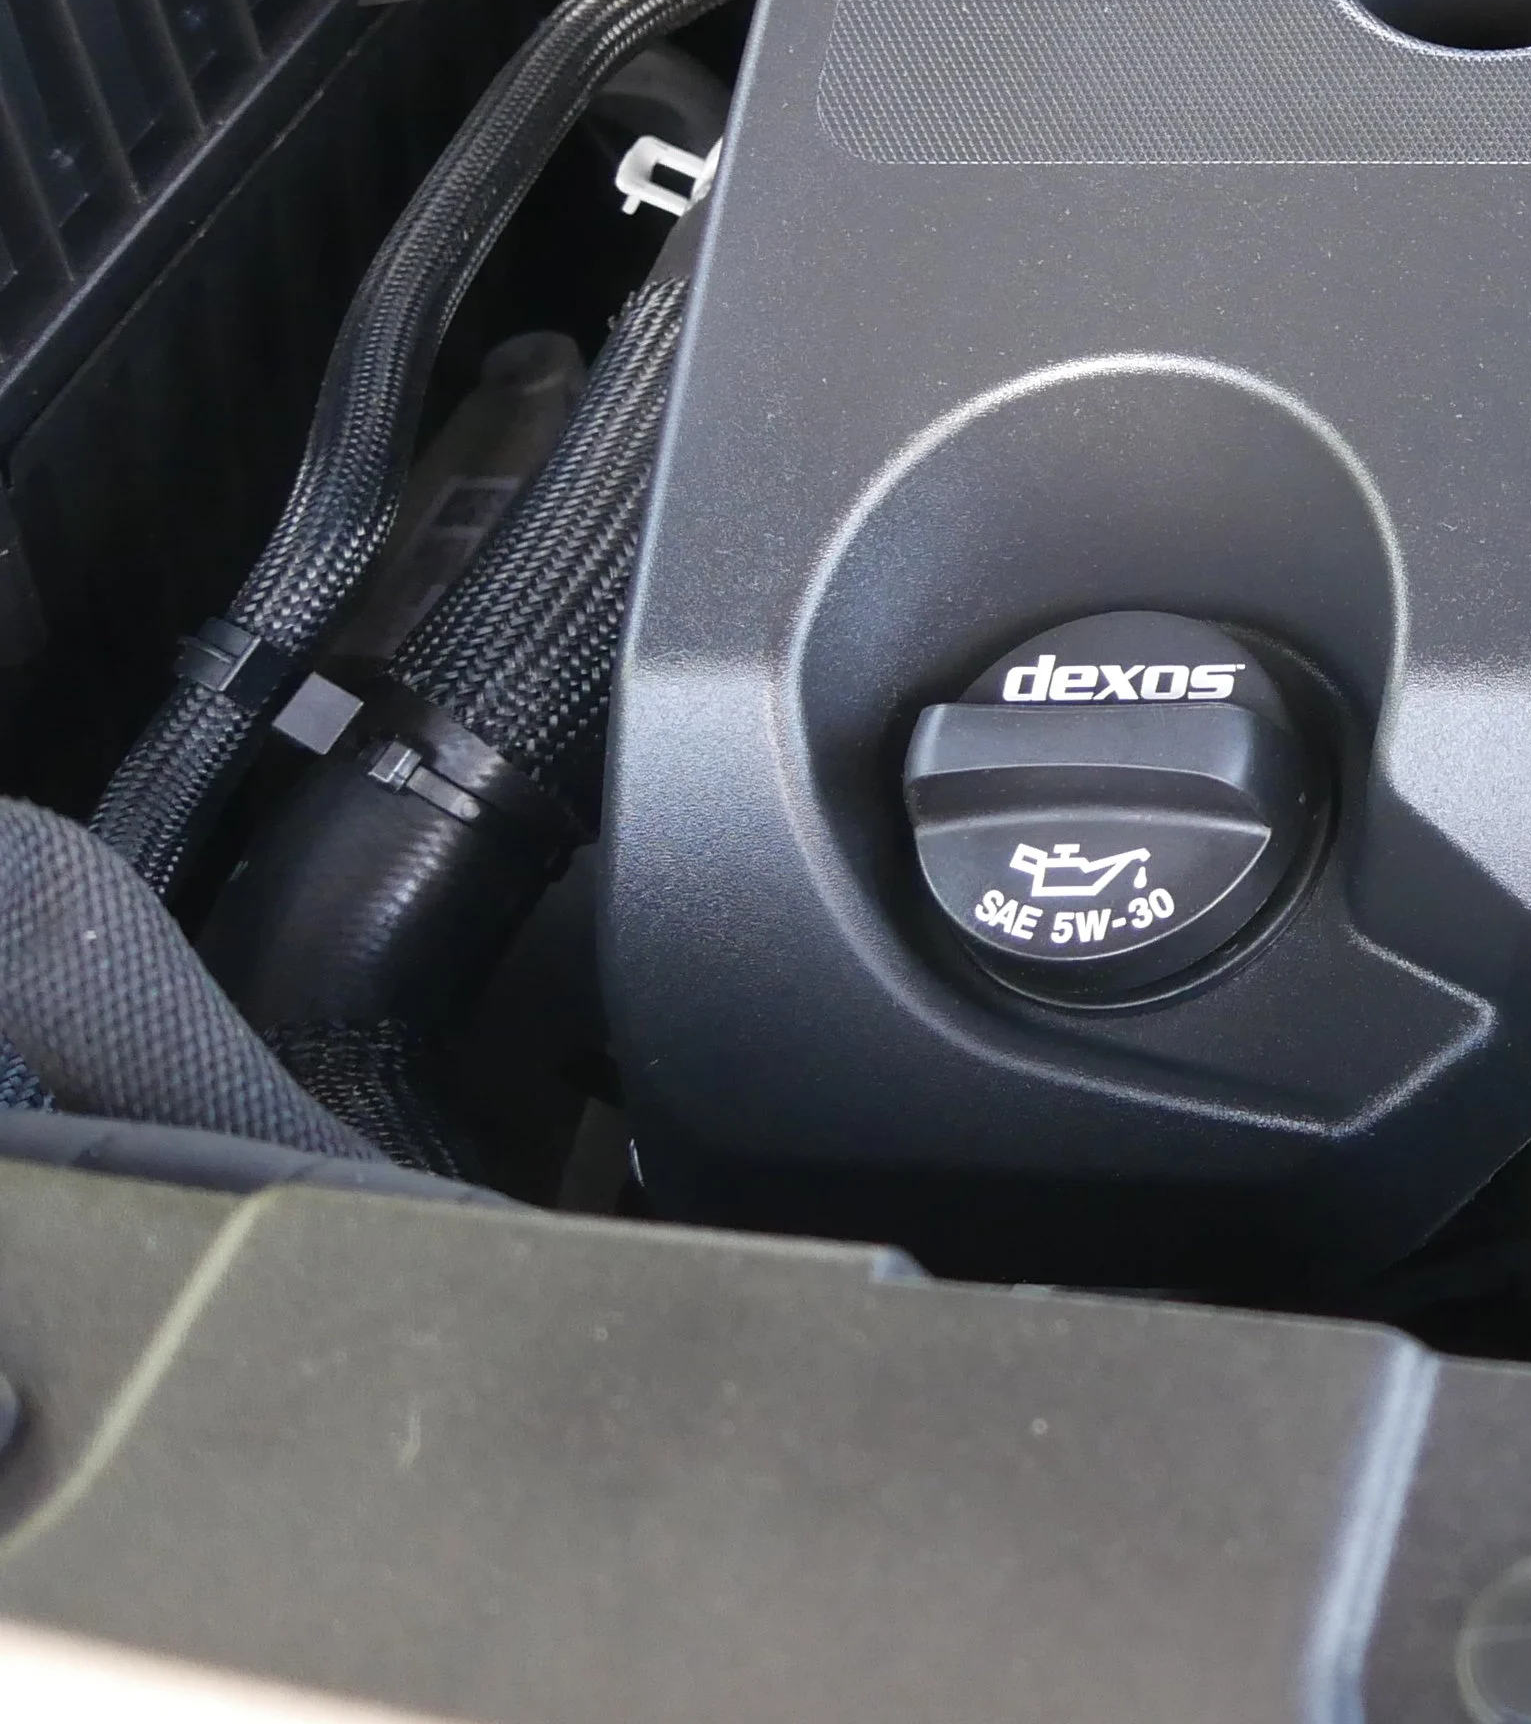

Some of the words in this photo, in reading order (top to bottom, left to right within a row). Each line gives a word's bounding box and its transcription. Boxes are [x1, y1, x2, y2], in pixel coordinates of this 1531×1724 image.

[1002, 654, 1237, 702] dexos
[974, 889, 1043, 941] SAE
[1050, 887, 1175, 943] 5W-30
